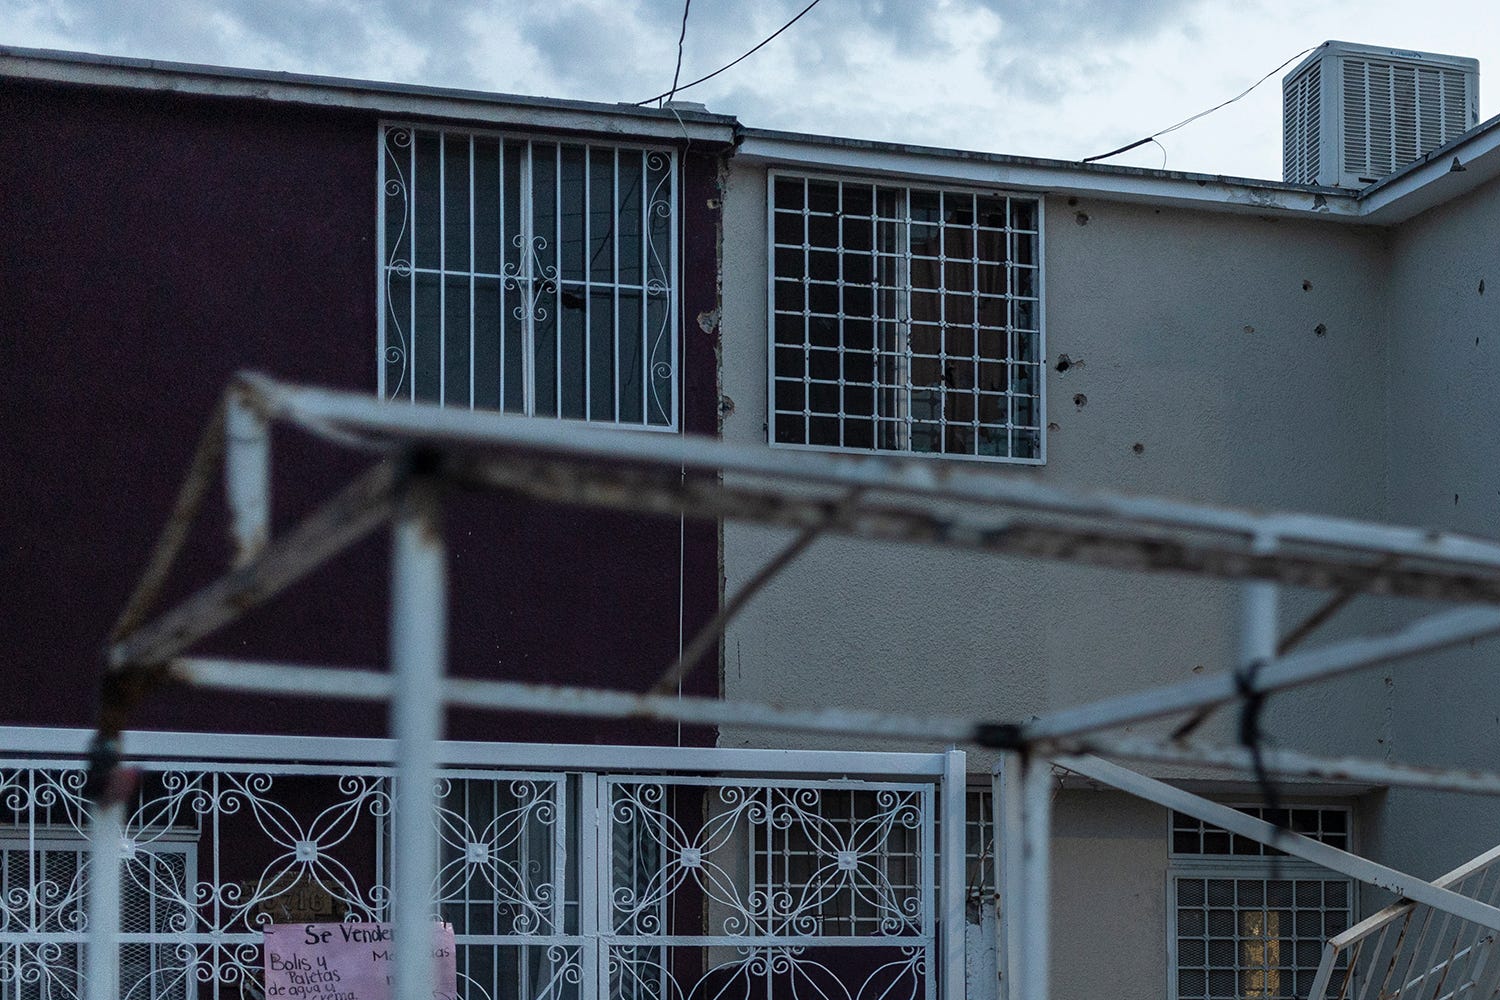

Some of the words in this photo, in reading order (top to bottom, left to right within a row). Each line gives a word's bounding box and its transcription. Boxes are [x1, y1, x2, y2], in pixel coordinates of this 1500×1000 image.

[304, 924, 332, 945] Se
[270, 952, 312, 971] Bolis
[286, 969, 341, 985] Paletas
[268, 982, 286, 996] de
[288, 984, 321, 999] agua
